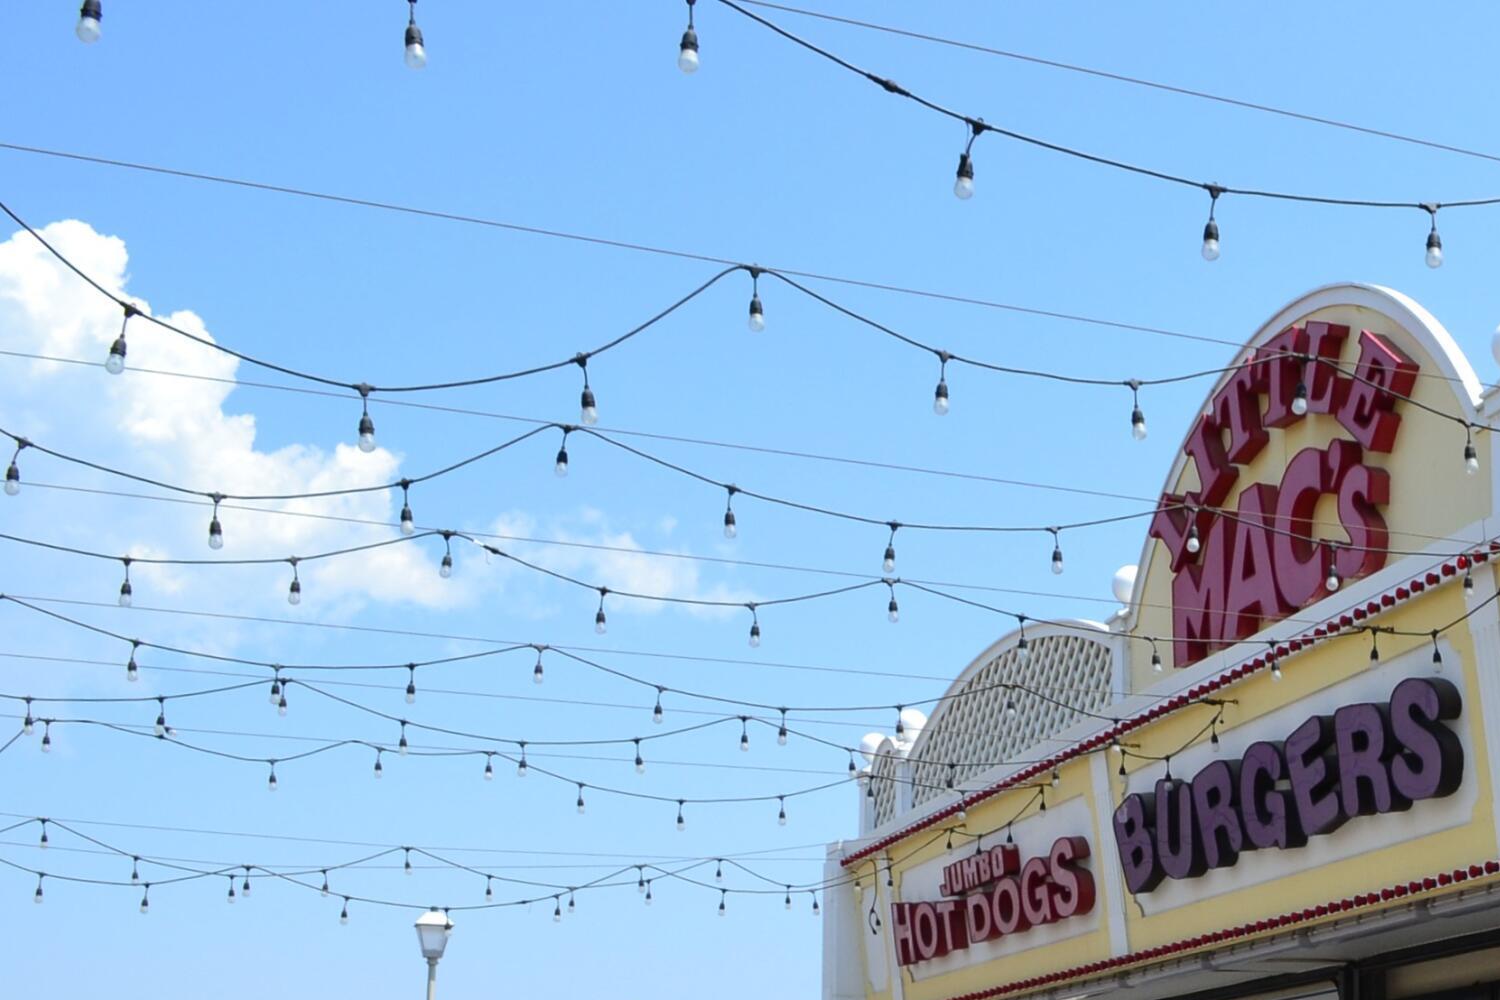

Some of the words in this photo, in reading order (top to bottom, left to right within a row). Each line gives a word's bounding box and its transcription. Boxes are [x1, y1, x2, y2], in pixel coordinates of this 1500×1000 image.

[1150, 320, 1418, 573] LITTLE
[1172, 438, 1390, 668] MAC'S
[939, 844, 1020, 897] JUMBO
[1113, 677, 1464, 894] BURGERS
[891, 900, 969, 966] HOT
[967, 836, 1096, 943] DOGS
